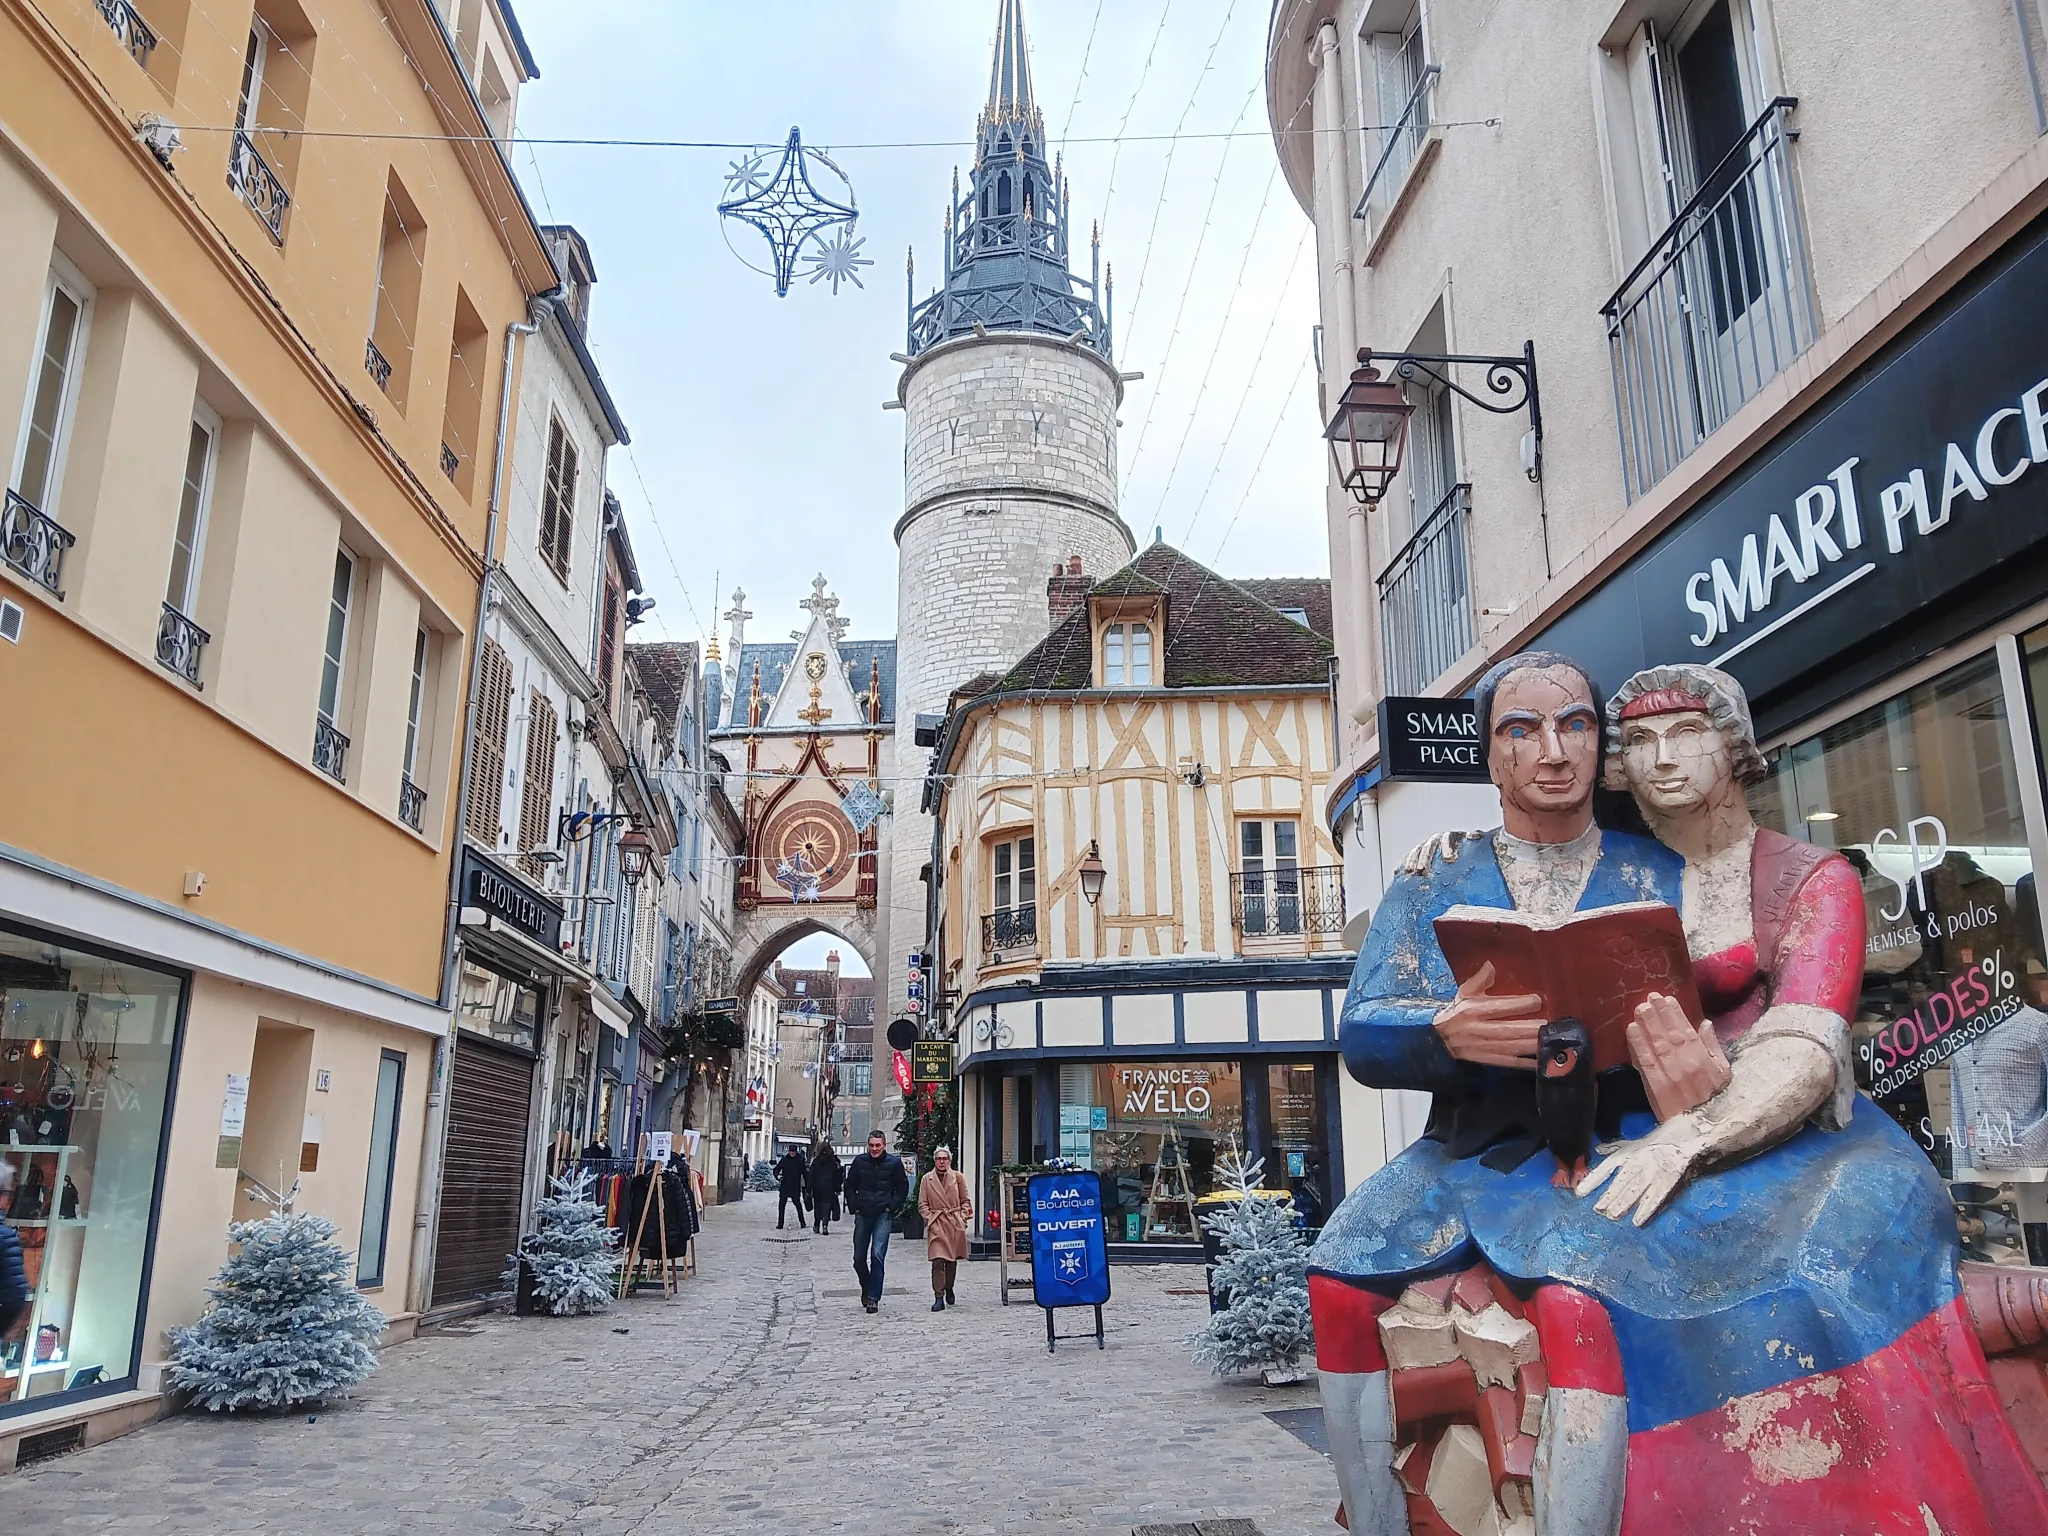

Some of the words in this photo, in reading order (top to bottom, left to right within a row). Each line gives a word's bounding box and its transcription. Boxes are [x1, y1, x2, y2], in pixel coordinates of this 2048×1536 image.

[1685, 456, 1862, 647] SMART
[1880, 378, 2048, 554] PLACE
[1407, 712, 1478, 735] SMAR
[1420, 746, 1480, 764] PLACE
[1873, 816, 1947, 921] SP
[479, 871, 547, 934] BIJOUTERIE
[1927, 912, 1942, 939] &
[1947, 900, 1998, 940] polos
[319, 1074, 329, 1088] 16
[896, 1055, 910, 1090] TABAC
[1122, 1069, 1192, 1090] FRANCE
[1132, 1084, 1210, 1112] VÉLO
[1036, 1198, 1095, 1210] Boutique
[1050, 1188, 1080, 1199] AJA
[1037, 1218, 1097, 1232] OUVERT
